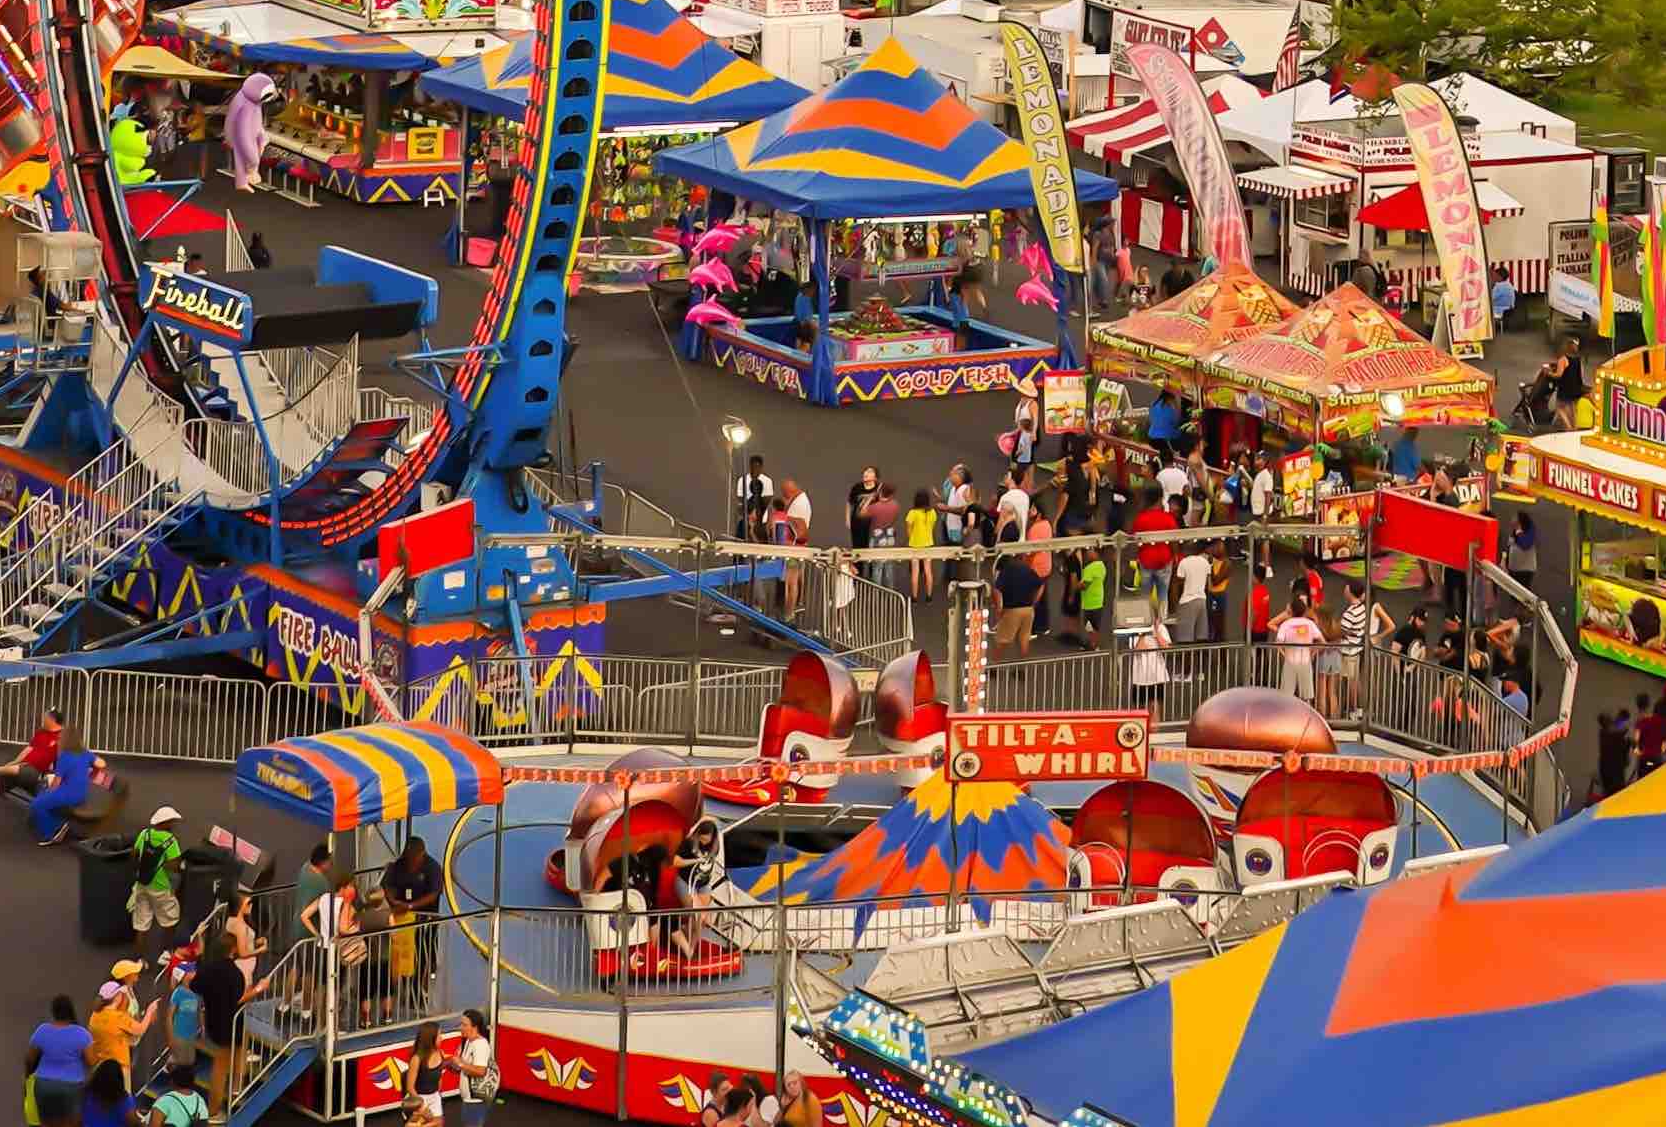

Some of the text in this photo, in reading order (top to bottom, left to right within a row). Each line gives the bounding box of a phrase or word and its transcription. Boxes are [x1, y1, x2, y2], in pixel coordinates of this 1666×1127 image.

[1013, 37, 1076, 239] LEMONADE
[1383, 147, 1412, 156] POLIS
[1423, 123, 1484, 331] LEMONADE
[143, 266, 245, 330] Fireball
[896, 363, 1012, 395] GOLD FISH
[1418, 379, 1488, 397] Lemonade
[1547, 463, 1638, 511] FUNNEL CAKES
[277, 608, 362, 678] FIRE BALL
[961, 724, 1089, 748] TILT-A-
[1013, 752, 1145, 775] WHIRL
